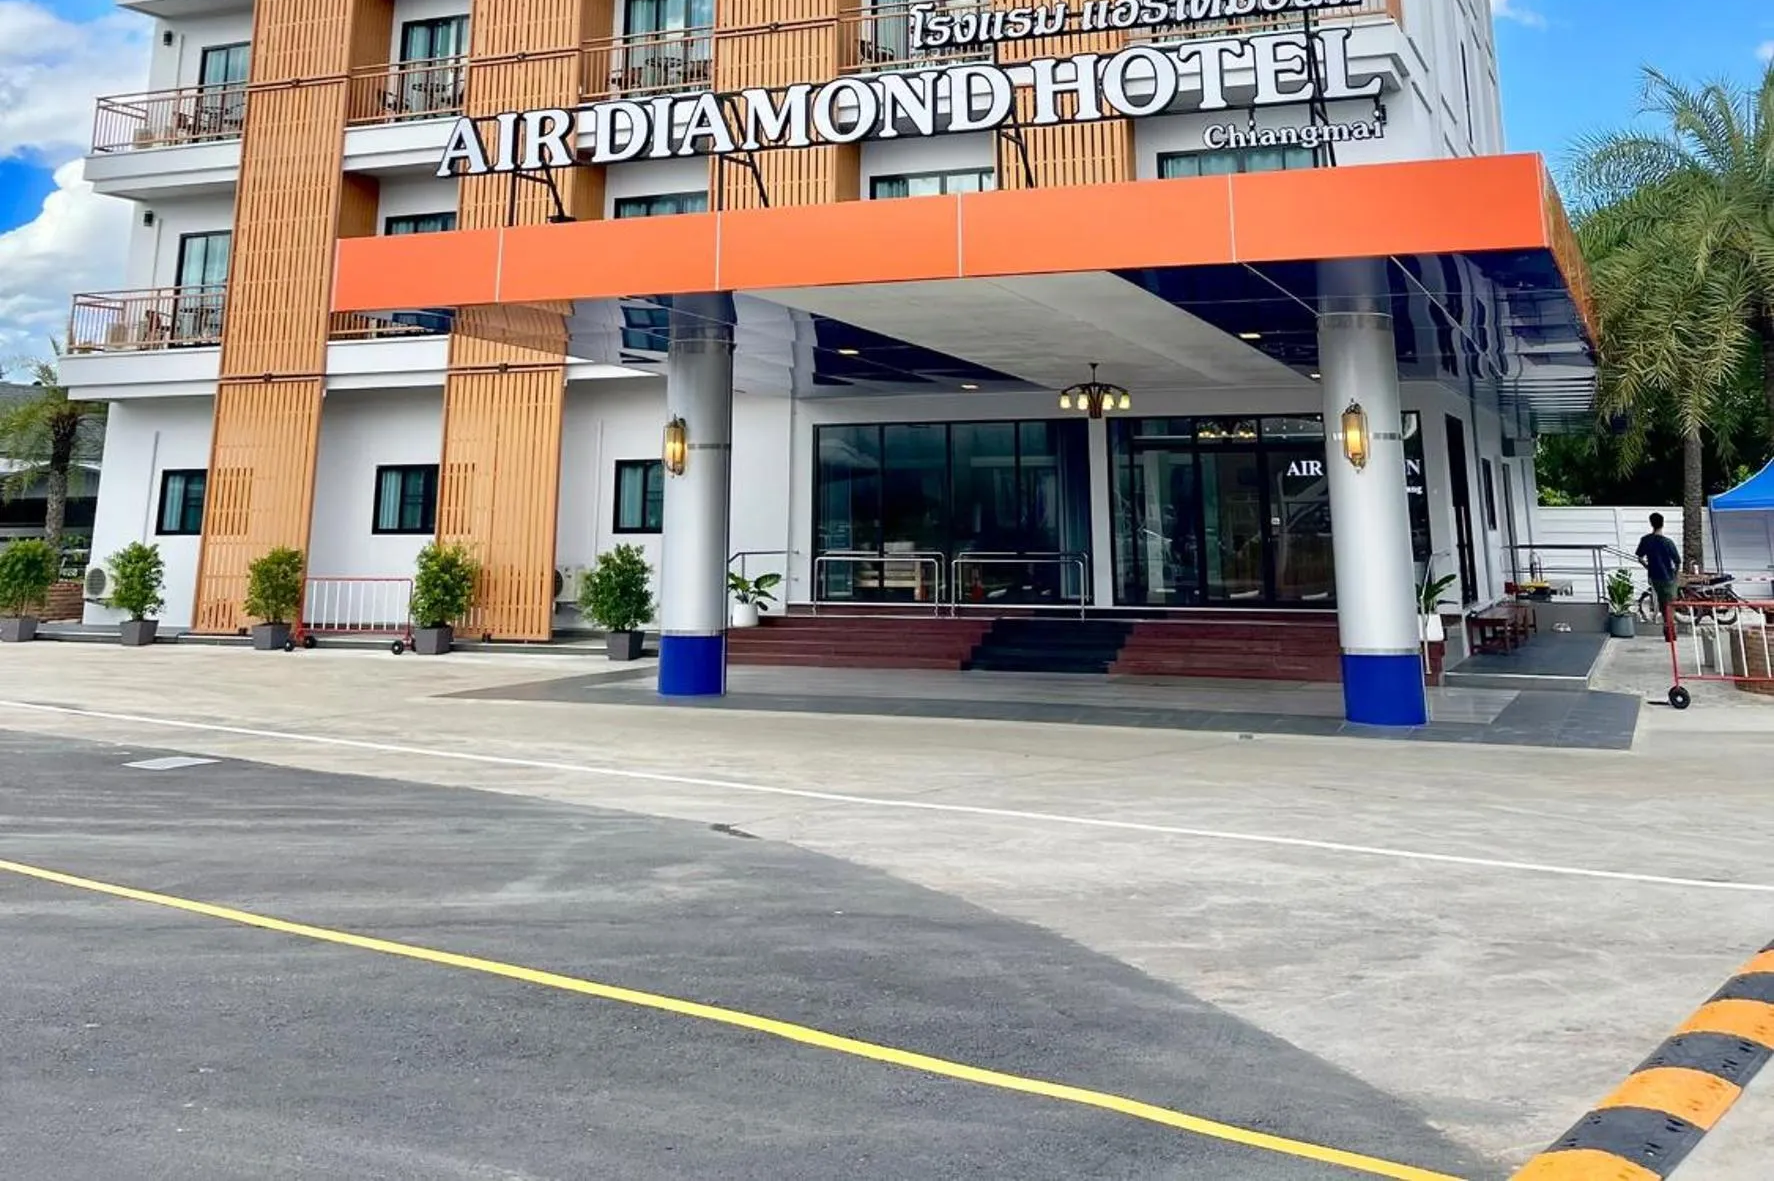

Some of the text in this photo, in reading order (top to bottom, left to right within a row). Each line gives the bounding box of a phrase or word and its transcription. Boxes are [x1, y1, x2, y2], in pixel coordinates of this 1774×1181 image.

[909, 2, 1067, 48] โรงแรม
[437, 28, 1385, 177] AIR DIAMOND HOTEL
[1203, 110, 1384, 149] Chiangmai
[1286, 459, 1324, 476] AIR
